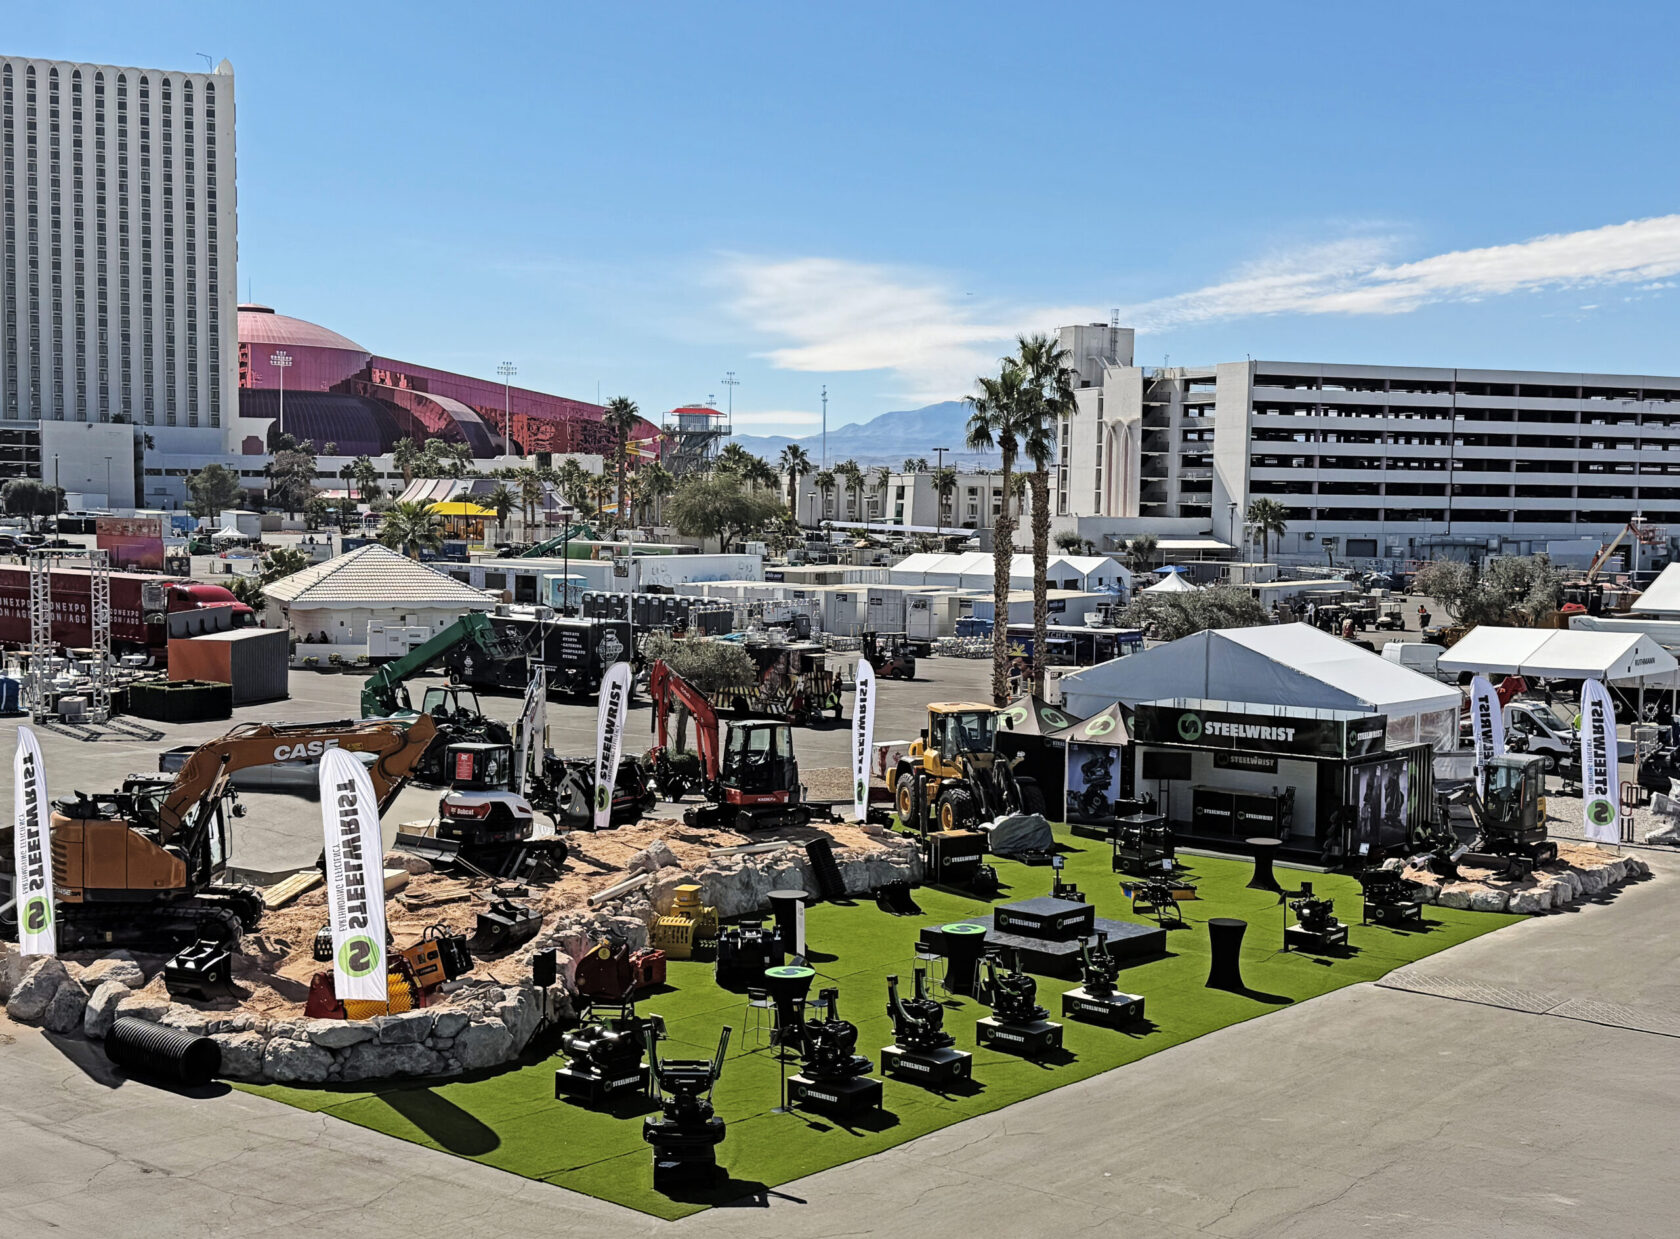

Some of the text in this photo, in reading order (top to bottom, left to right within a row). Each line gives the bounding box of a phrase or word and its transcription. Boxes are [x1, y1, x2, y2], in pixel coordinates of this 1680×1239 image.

[0, 597, 31, 608] NEXPO
[1634, 657, 1656, 667] RUTHMANN
[600, 681, 622, 781] STEELWRIST
[1204, 721, 1296, 742] STEELWRIST
[1357, 727, 1384, 742] STEELWRIST
[273, 738, 340, 761] CASE
[1230, 754, 1275, 768] STEELWRIST
[457, 808, 474, 816] Bobcat
[1203, 807, 1231, 817] STEELWRIST
[1245, 811, 1274, 822] STEELWRIST
[1009, 917, 1041, 929] STEELWRIST
[1080, 1003, 1110, 1014] STEELWRIST
[995, 1031, 1025, 1043] STEELWRIST
[900, 1060, 931, 1073] STEELWRIST
[612, 1074, 641, 1088] STEELWRIST
[807, 1089, 838, 1103] STEELWRIST
